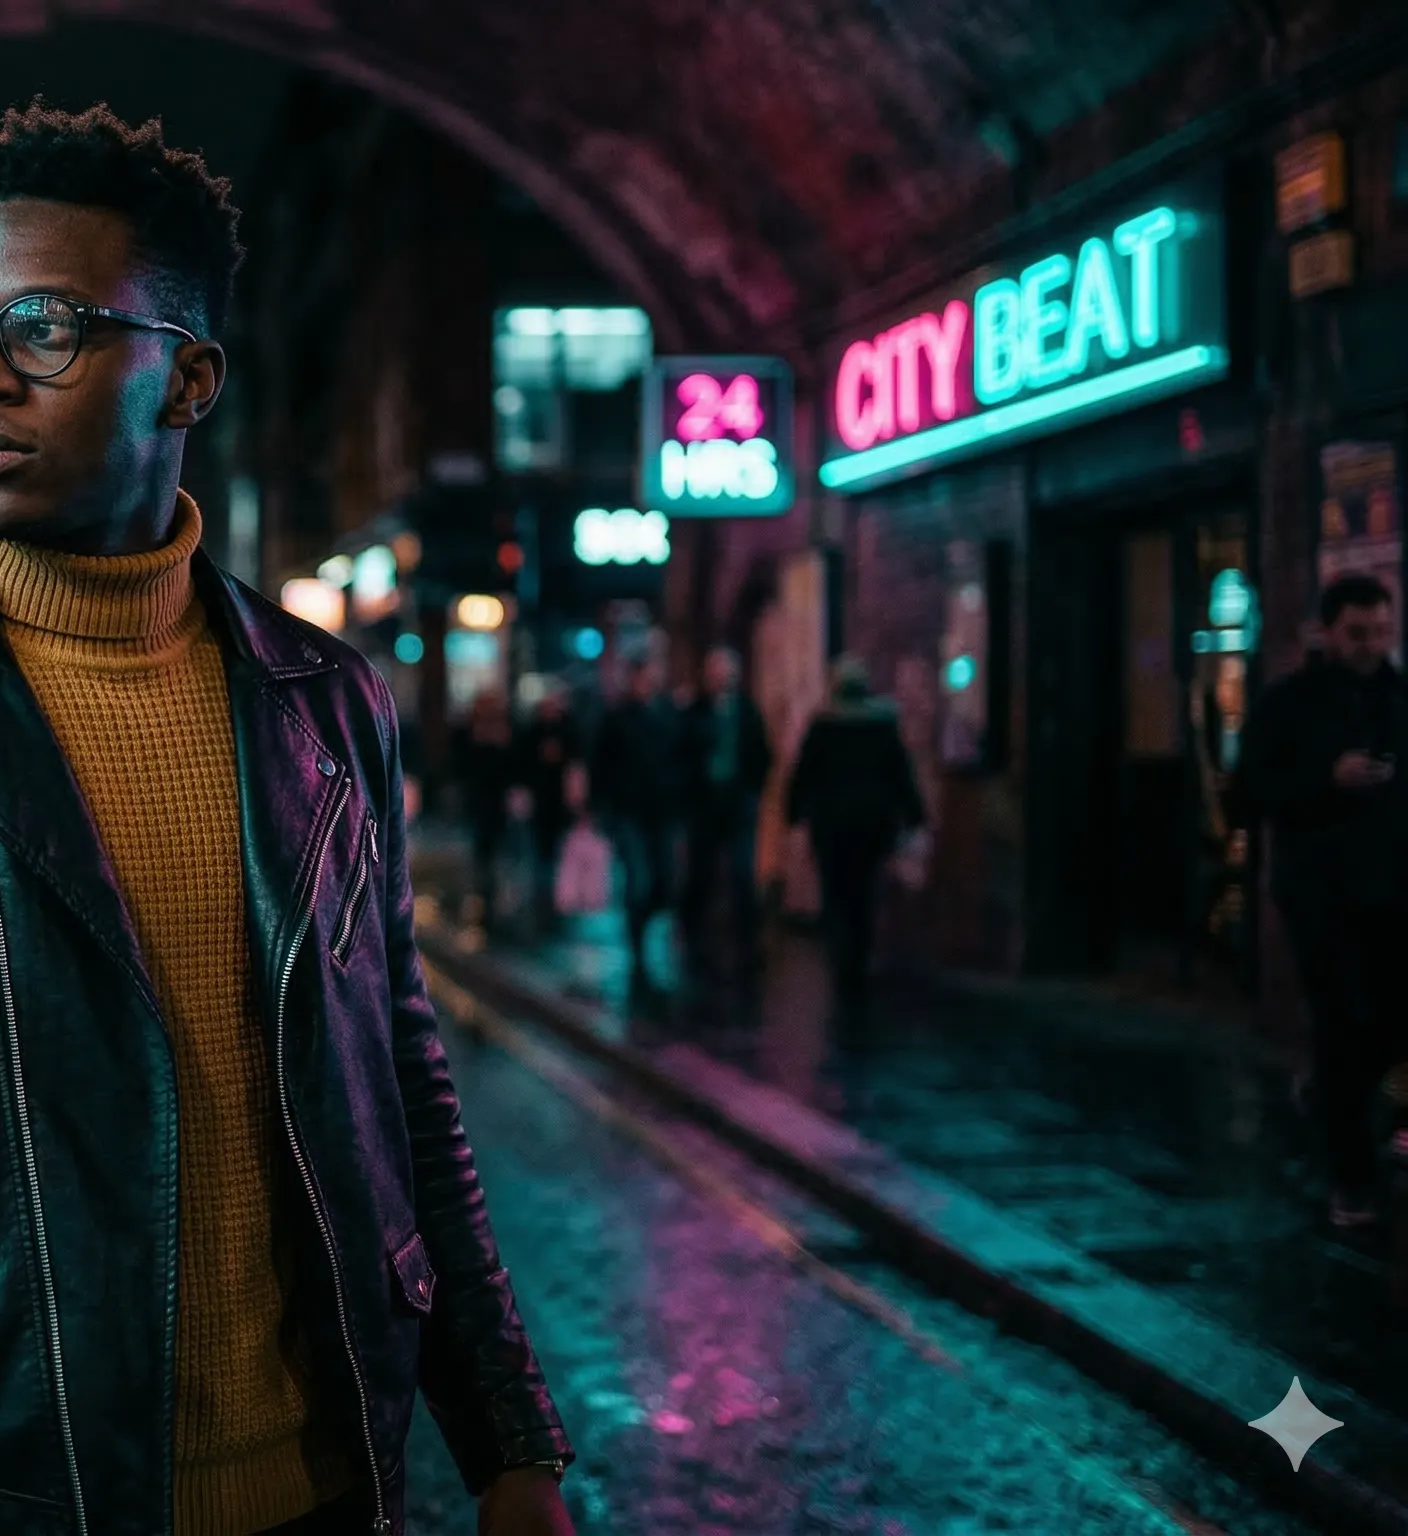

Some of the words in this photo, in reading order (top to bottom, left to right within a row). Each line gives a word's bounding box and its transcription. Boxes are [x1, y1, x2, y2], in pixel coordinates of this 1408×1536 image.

[835, 299, 970, 451] CITY
[973, 206, 1177, 406] BEAT
[676, 373, 765, 441] 24
